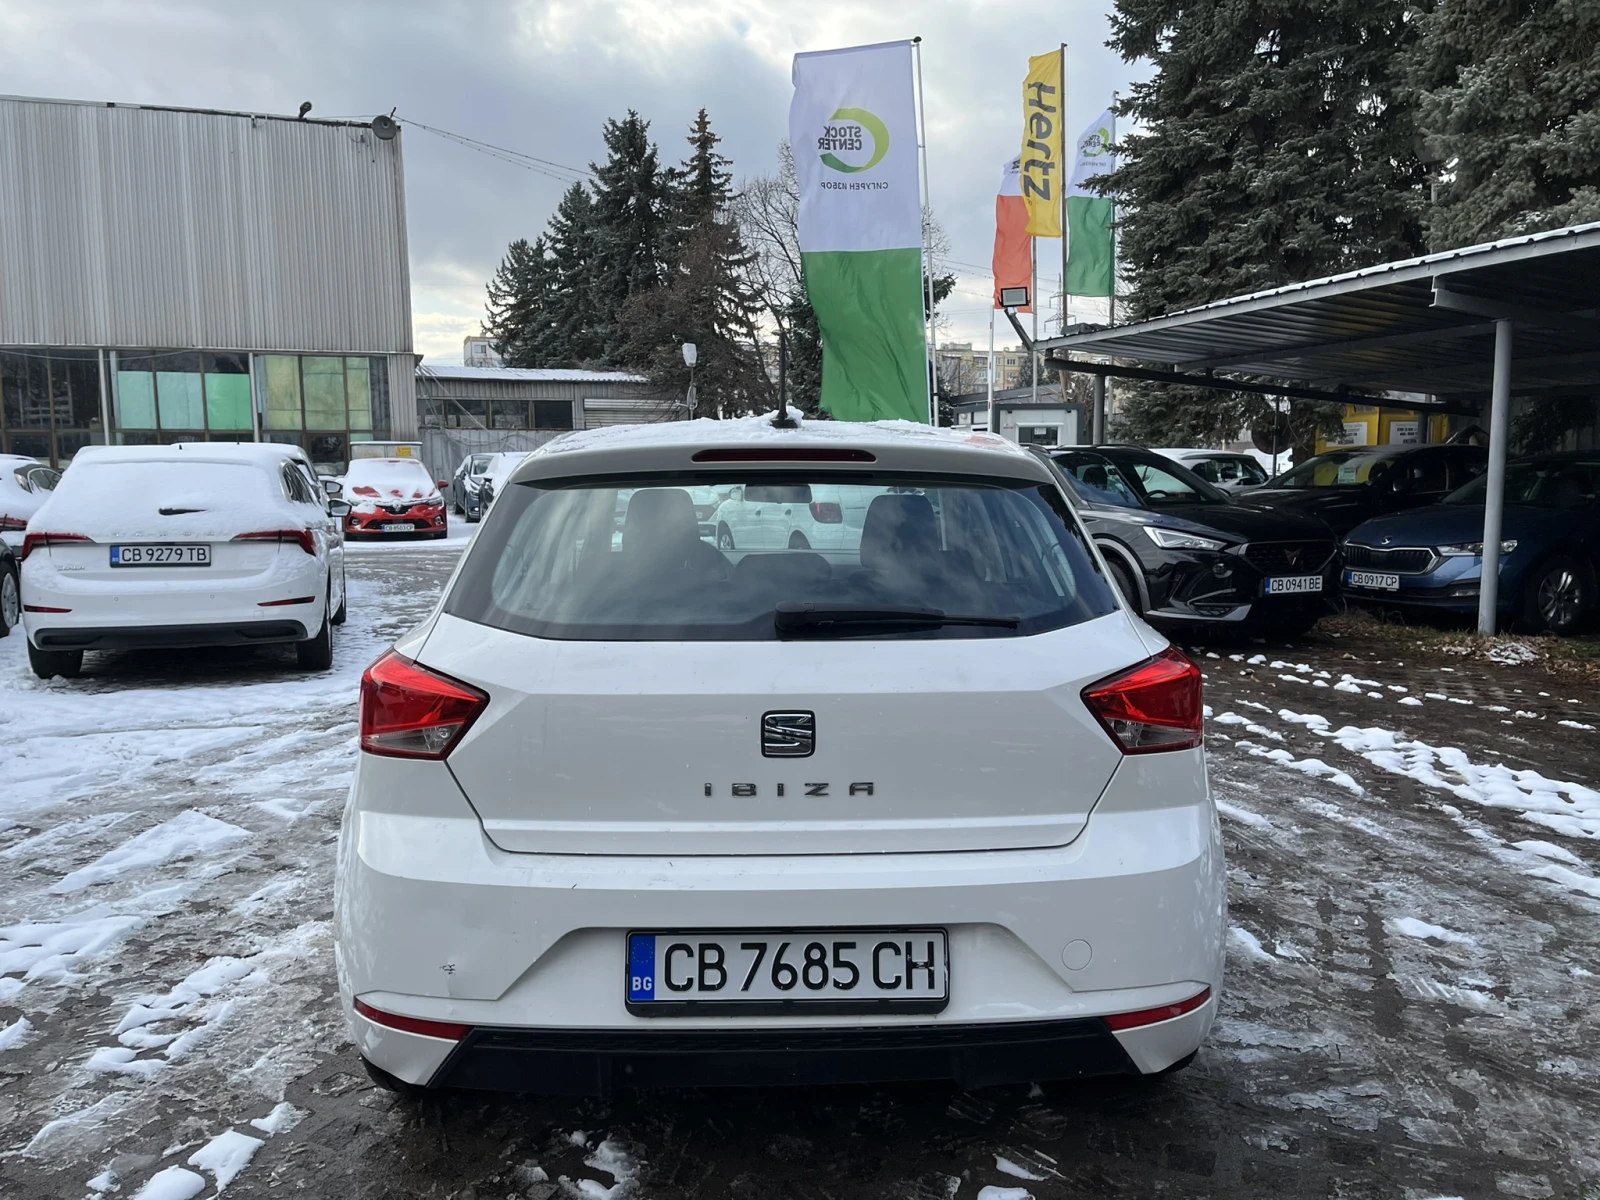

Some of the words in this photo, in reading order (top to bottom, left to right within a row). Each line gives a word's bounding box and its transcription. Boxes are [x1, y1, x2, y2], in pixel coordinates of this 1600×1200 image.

[1024, 82, 1056, 201] Hertz
[122, 548, 142, 562] CB
[146, 548, 183, 561] 9279
[187, 547, 207, 561] TB
[1271, 579, 1284, 592] CB
[1285, 578, 1307, 590] 0941
[1309, 577, 1321, 589] BE
[1353, 573, 1363, 584] CB
[1364, 575, 1384, 585] 0917
[1386, 576, 1397, 586] CP
[704, 782, 874, 797] IBIZA
[664, 943, 727, 992] CB
[740, 942, 860, 991] 7685
[872, 941, 935, 990] CH
[632, 977, 652, 991] BG
